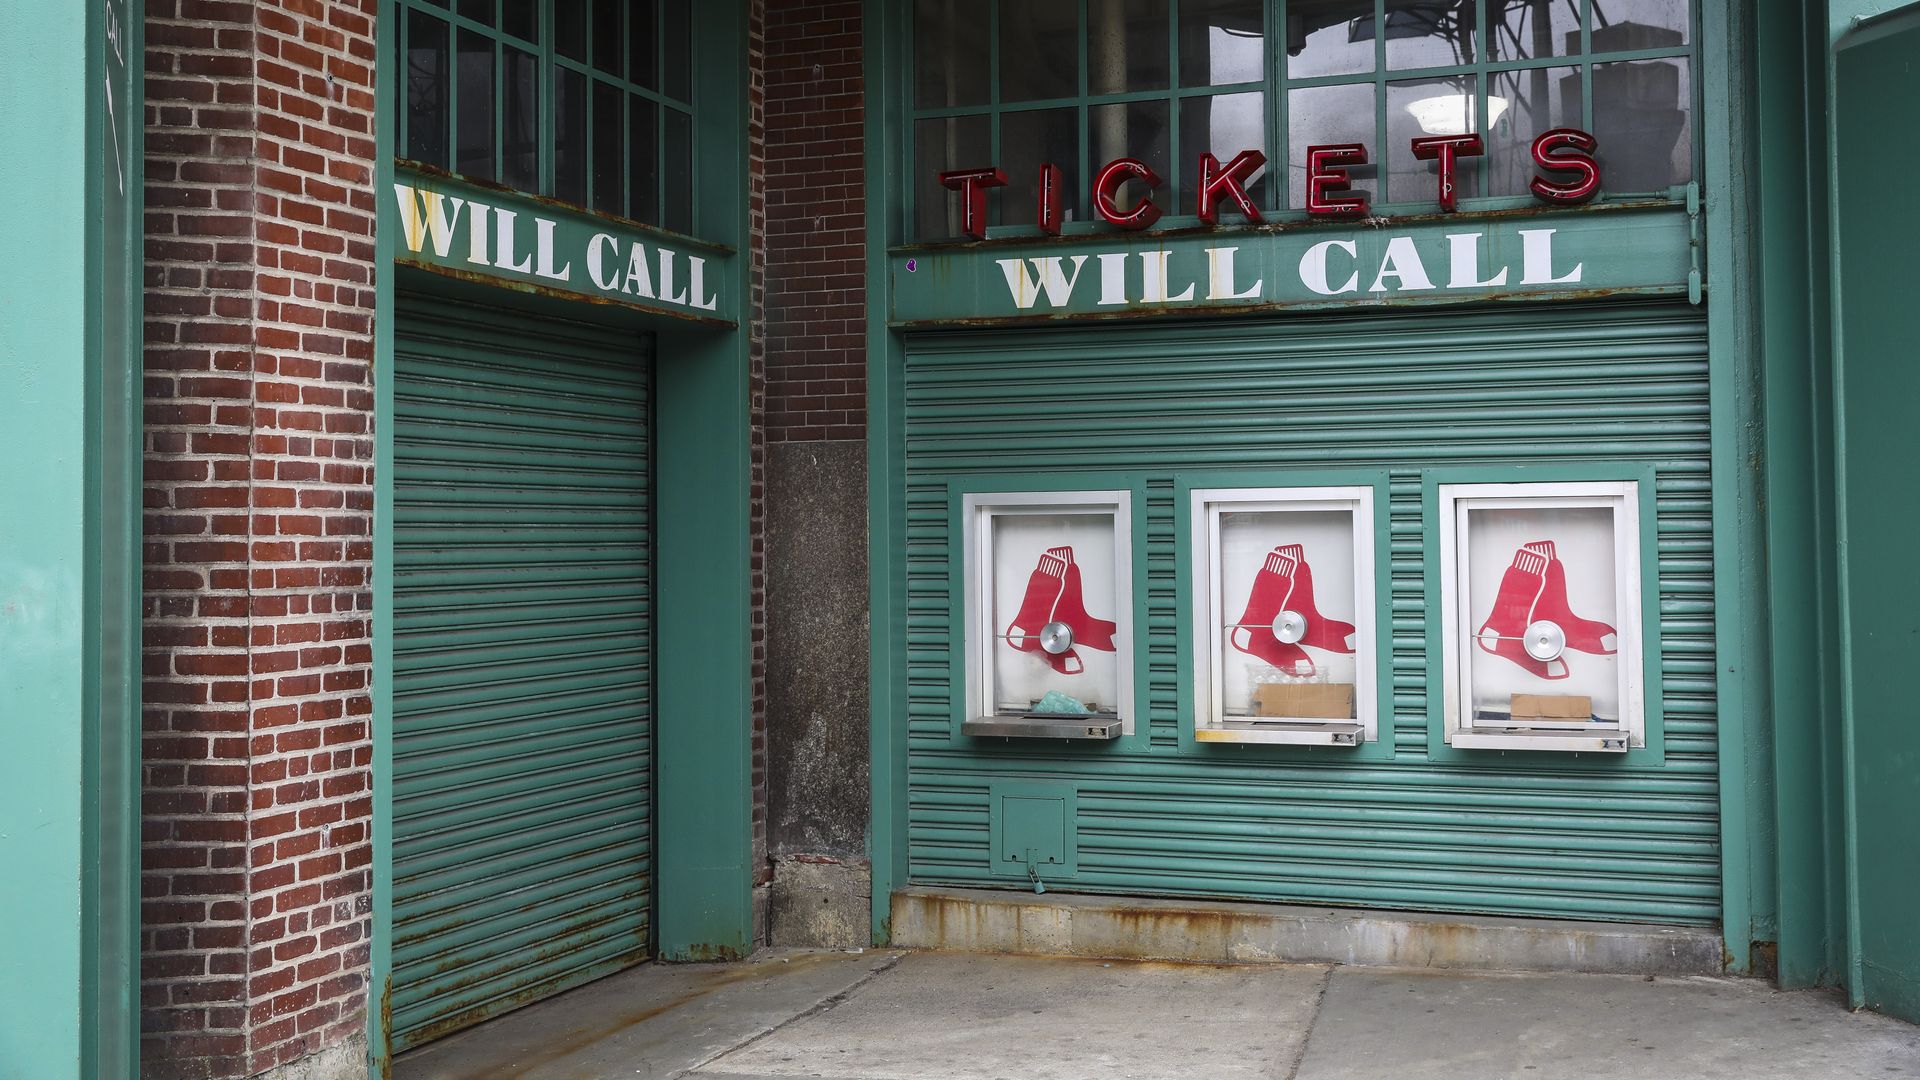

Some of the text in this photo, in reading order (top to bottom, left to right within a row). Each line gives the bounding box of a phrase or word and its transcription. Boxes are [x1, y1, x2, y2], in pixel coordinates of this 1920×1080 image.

[939, 127, 1602, 237] TICKETS
[394, 184, 717, 310] WILL CALL
[996, 228, 1583, 308] WILL CALL
